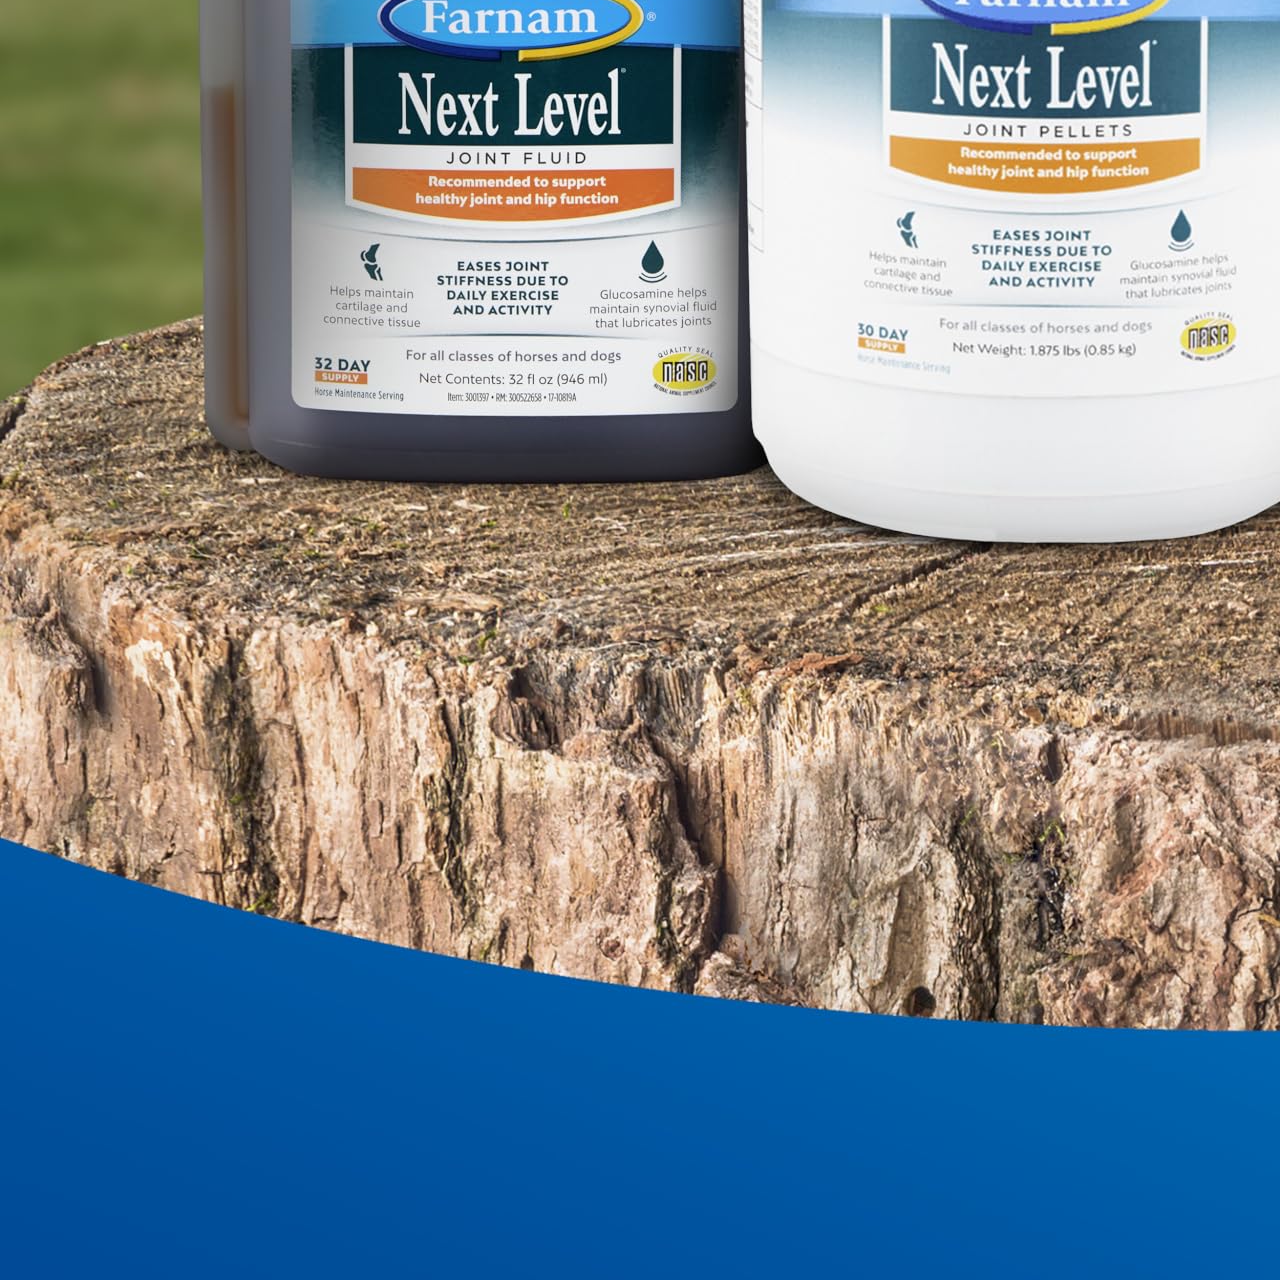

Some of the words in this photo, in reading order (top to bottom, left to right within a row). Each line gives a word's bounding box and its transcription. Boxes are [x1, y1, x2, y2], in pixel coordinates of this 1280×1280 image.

[422, 0, 597, 33] Farnam
[932, 42, 1031, 108] Next
[1046, 40, 1154, 109] Level
[398, 72, 498, 136] Next
[514, 68, 622, 136] Level
[963, 123, 1026, 136] JOINT
[1040, 124, 1131, 137] PELLETS
[446, 152, 510, 164] JOINT
[524, 152, 585, 164] FLUID
[961, 146, 1061, 159] Recommended
[1065, 150, 1080, 160] to
[1083, 148, 1136, 162] support
[948, 163, 998, 179] healthy
[1001, 165, 1033, 179] joint
[1037, 166, 1063, 177] and
[1066, 166, 1088, 179] hip
[1091, 164, 1148, 176] function
[429, 175, 530, 187] Recommended
[534, 177, 548, 187] to
[552, 176, 605, 189] support
[416, 192, 467, 207] healthy
[469, 193, 502, 207] joint
[506, 193, 531, 204] and
[535, 193, 556, 207] hip
[560, 192, 618, 204] function
[458, 261, 500, 271] EASES
[506, 261, 548, 271] JOINT
[437, 275, 511, 285] STIFFNESS
[517, 276, 545, 285] DUE
[549, 276, 567, 285] TO
[329, 285, 360, 298] Helps
[364, 288, 413, 298] maintain
[447, 290, 486, 300] DAILY
[491, 290, 558, 300] EXERCISE
[600, 288, 673, 299] Glucosamine
[677, 286, 708, 301] helps
[335, 301, 382, 313] cartilage
[386, 303, 407, 312] and
[453, 305, 484, 314] AND
[488, 305, 552, 314] ACTIVITY
[589, 303, 639, 313] maintain
[643, 301, 688, 315] synovial
[693, 299, 718, 315] fluid
[322, 315, 384, 326] connective
[388, 317, 420, 327] tissue
[595, 318, 618, 328] that
[622, 317, 677, 327] lubricates
[680, 314, 713, 329] joints
[858, 323, 874, 336] 30
[879, 327, 908, 341] DAY
[658, 346, 692, 358] QUALITY
[696, 347, 714, 357] SEAL
[865, 340, 898, 351] SUPPLY
[953, 342, 973, 353] Net
[977, 344, 1025, 357] Weight:
[1030, 345, 1059, 356] 1.875
[1063, 345, 1080, 355] lbs
[1084, 344, 1114, 357] (0.85
[1118, 343, 1135, 356] kg)
[406, 349, 426, 360] For
[430, 350, 444, 360] all
[448, 350, 493, 361] classes
[498, 350, 511, 361] of
[515, 351, 557, 361] horses
[562, 350, 585, 361] and
[590, 350, 621, 363] dogs
[315, 357, 331, 369] 32
[338, 359, 370, 372] DAY
[322, 373, 359, 383] SUPPLY
[419, 373, 441, 383] Net
[445, 373, 504, 384] Contents:
[509, 374, 523, 384] 32
[527, 373, 534, 384] fl
[539, 376, 552, 384] oz
[557, 373, 584, 386] (946
[588, 373, 607, 385] ml)
[314, 386, 332, 396] Horse
[335, 388, 376, 398] Maintenance
[379, 391, 403, 401] Serving
